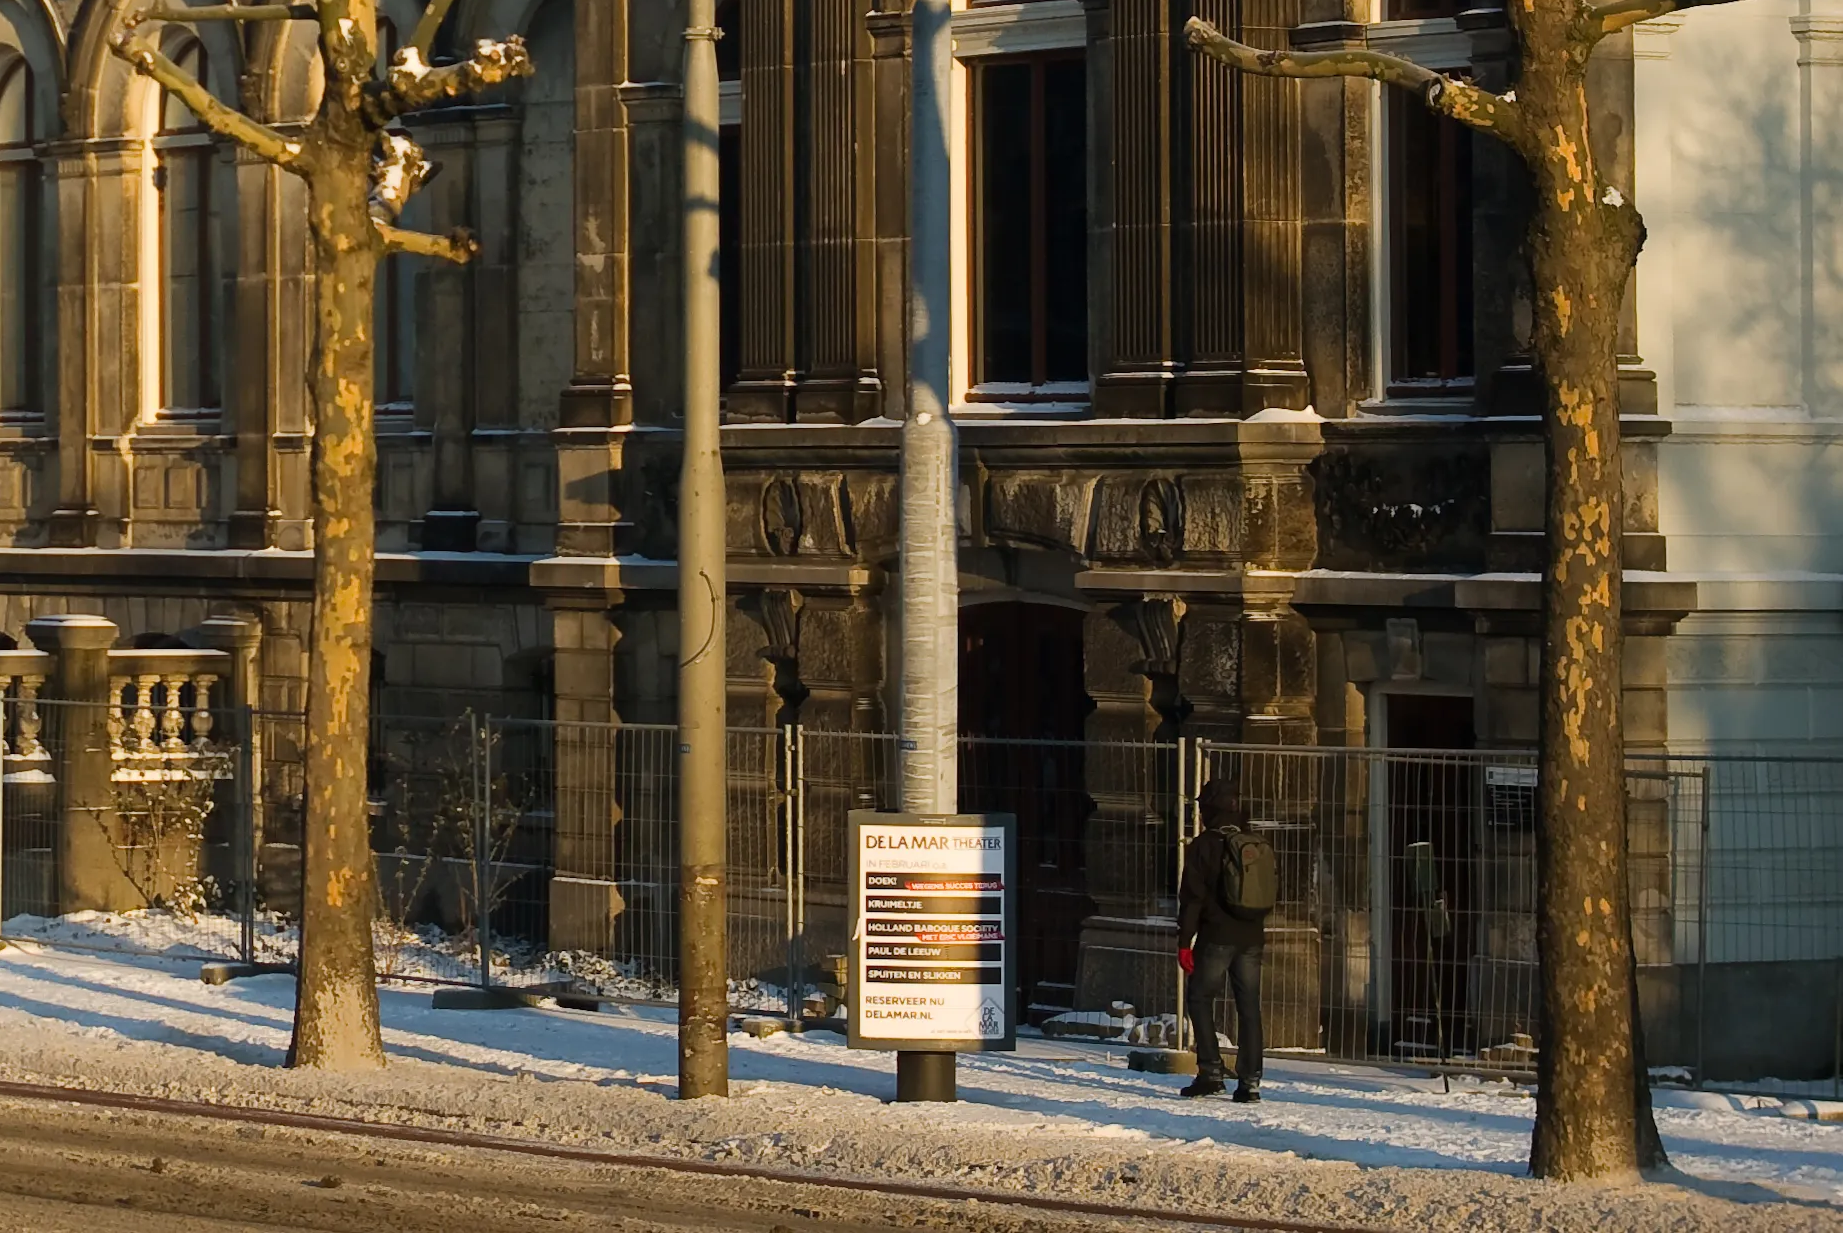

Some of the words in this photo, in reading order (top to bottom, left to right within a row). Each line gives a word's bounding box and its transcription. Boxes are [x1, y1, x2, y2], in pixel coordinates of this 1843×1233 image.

[953, 838, 1001, 849] THEATER
[866, 859, 877, 868] IN
[879, 859, 930, 869] FEBRUARI
[867, 899, 923, 909] KRUIMELTJE
[867, 923, 913, 933] HOLLAND
[914, 924, 960, 933] BAROQUE
[961, 924, 998, 933] SOCIETY
[867, 946, 892, 955] PAUL
[893, 947, 906, 956] DE
[908, 947, 942, 956] LEEUW
[867, 970, 907, 979] SPUITEN
[908, 971, 920, 979] EN
[922, 971, 962, 980] SLIKKEN
[865, 996, 927, 1006] RESERVEER
[929, 997, 945, 1006] NU
[865, 1009, 934, 1020] DELAMAR.NL
[983, 1006, 996, 1015] DE
[982, 1014, 994, 1022] LA
[979, 1021, 999, 1030] MAR
